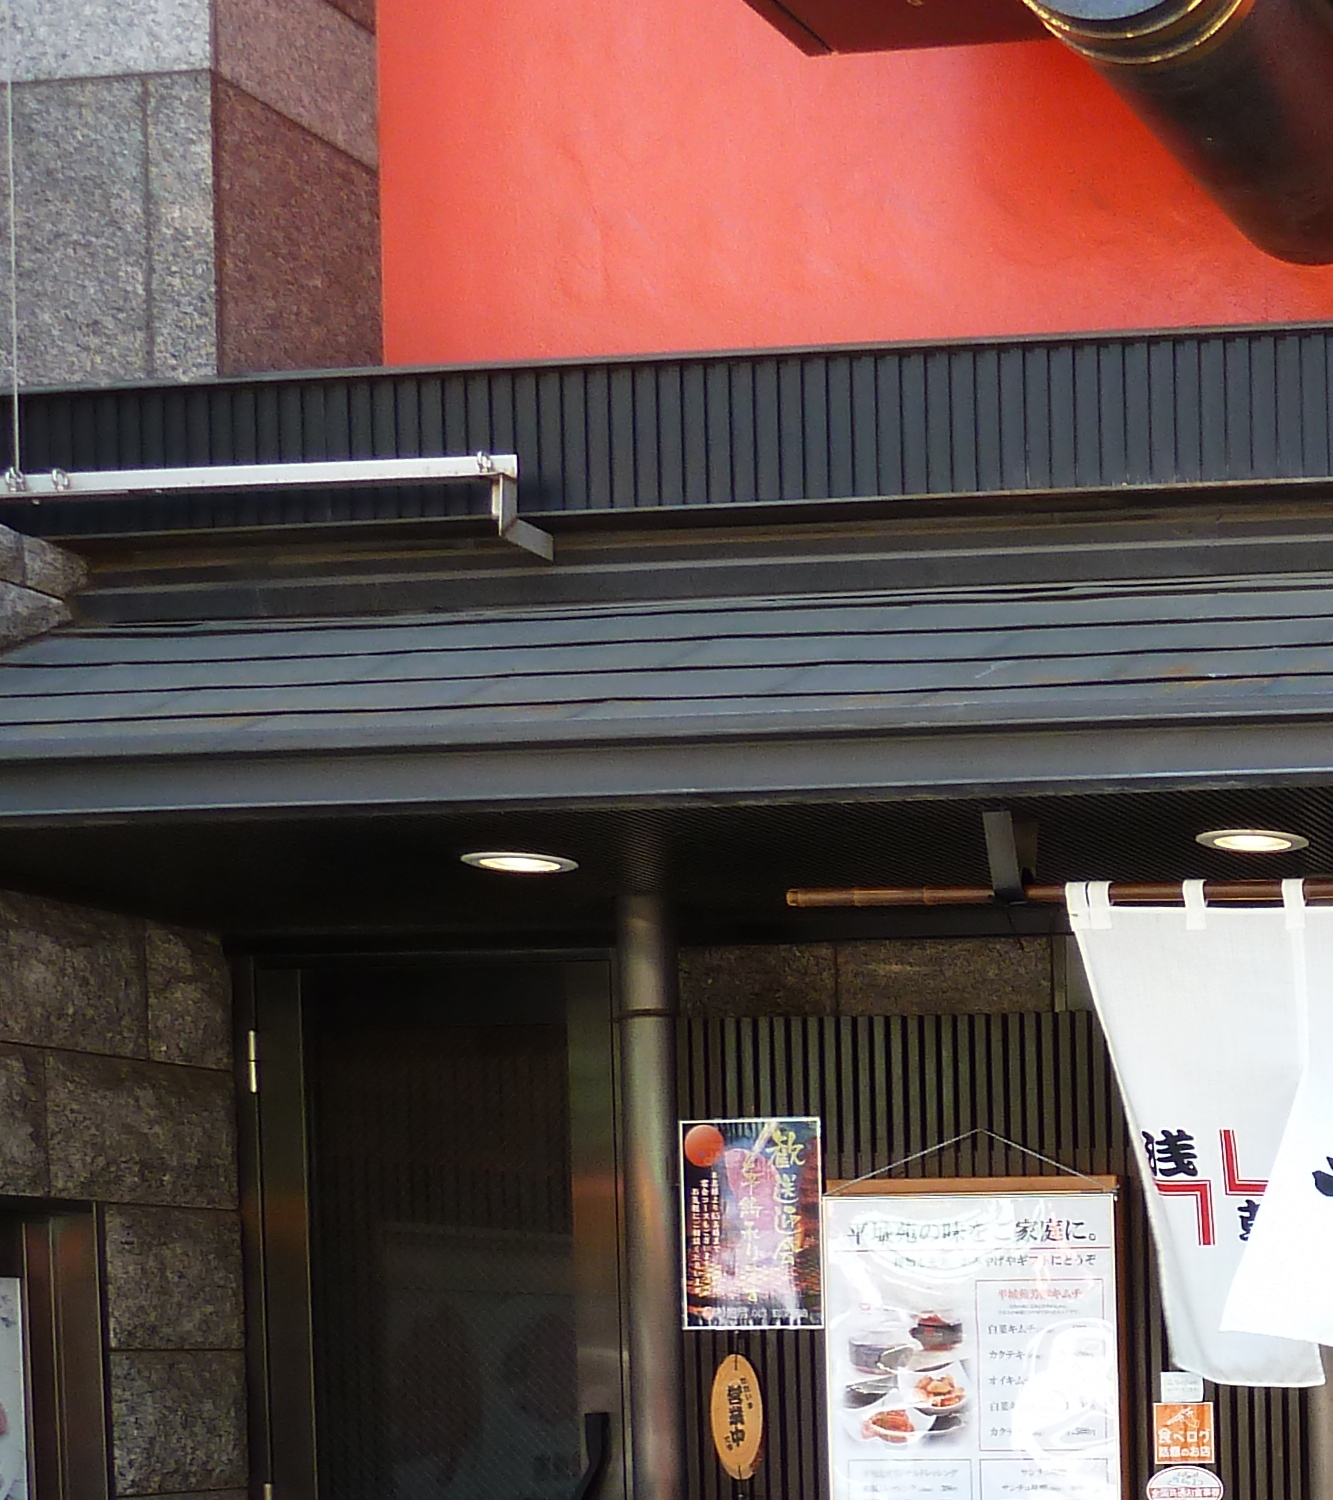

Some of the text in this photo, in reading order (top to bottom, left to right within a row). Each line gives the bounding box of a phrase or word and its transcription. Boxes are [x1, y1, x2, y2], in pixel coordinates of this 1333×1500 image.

[988, 1350, 1026, 1361] カクテキ
[988, 1376, 1029, 1386] オイキム
[727, 1384, 746, 1448] 営業中
[1157, 1427, 1212, 1445] 食べログ
